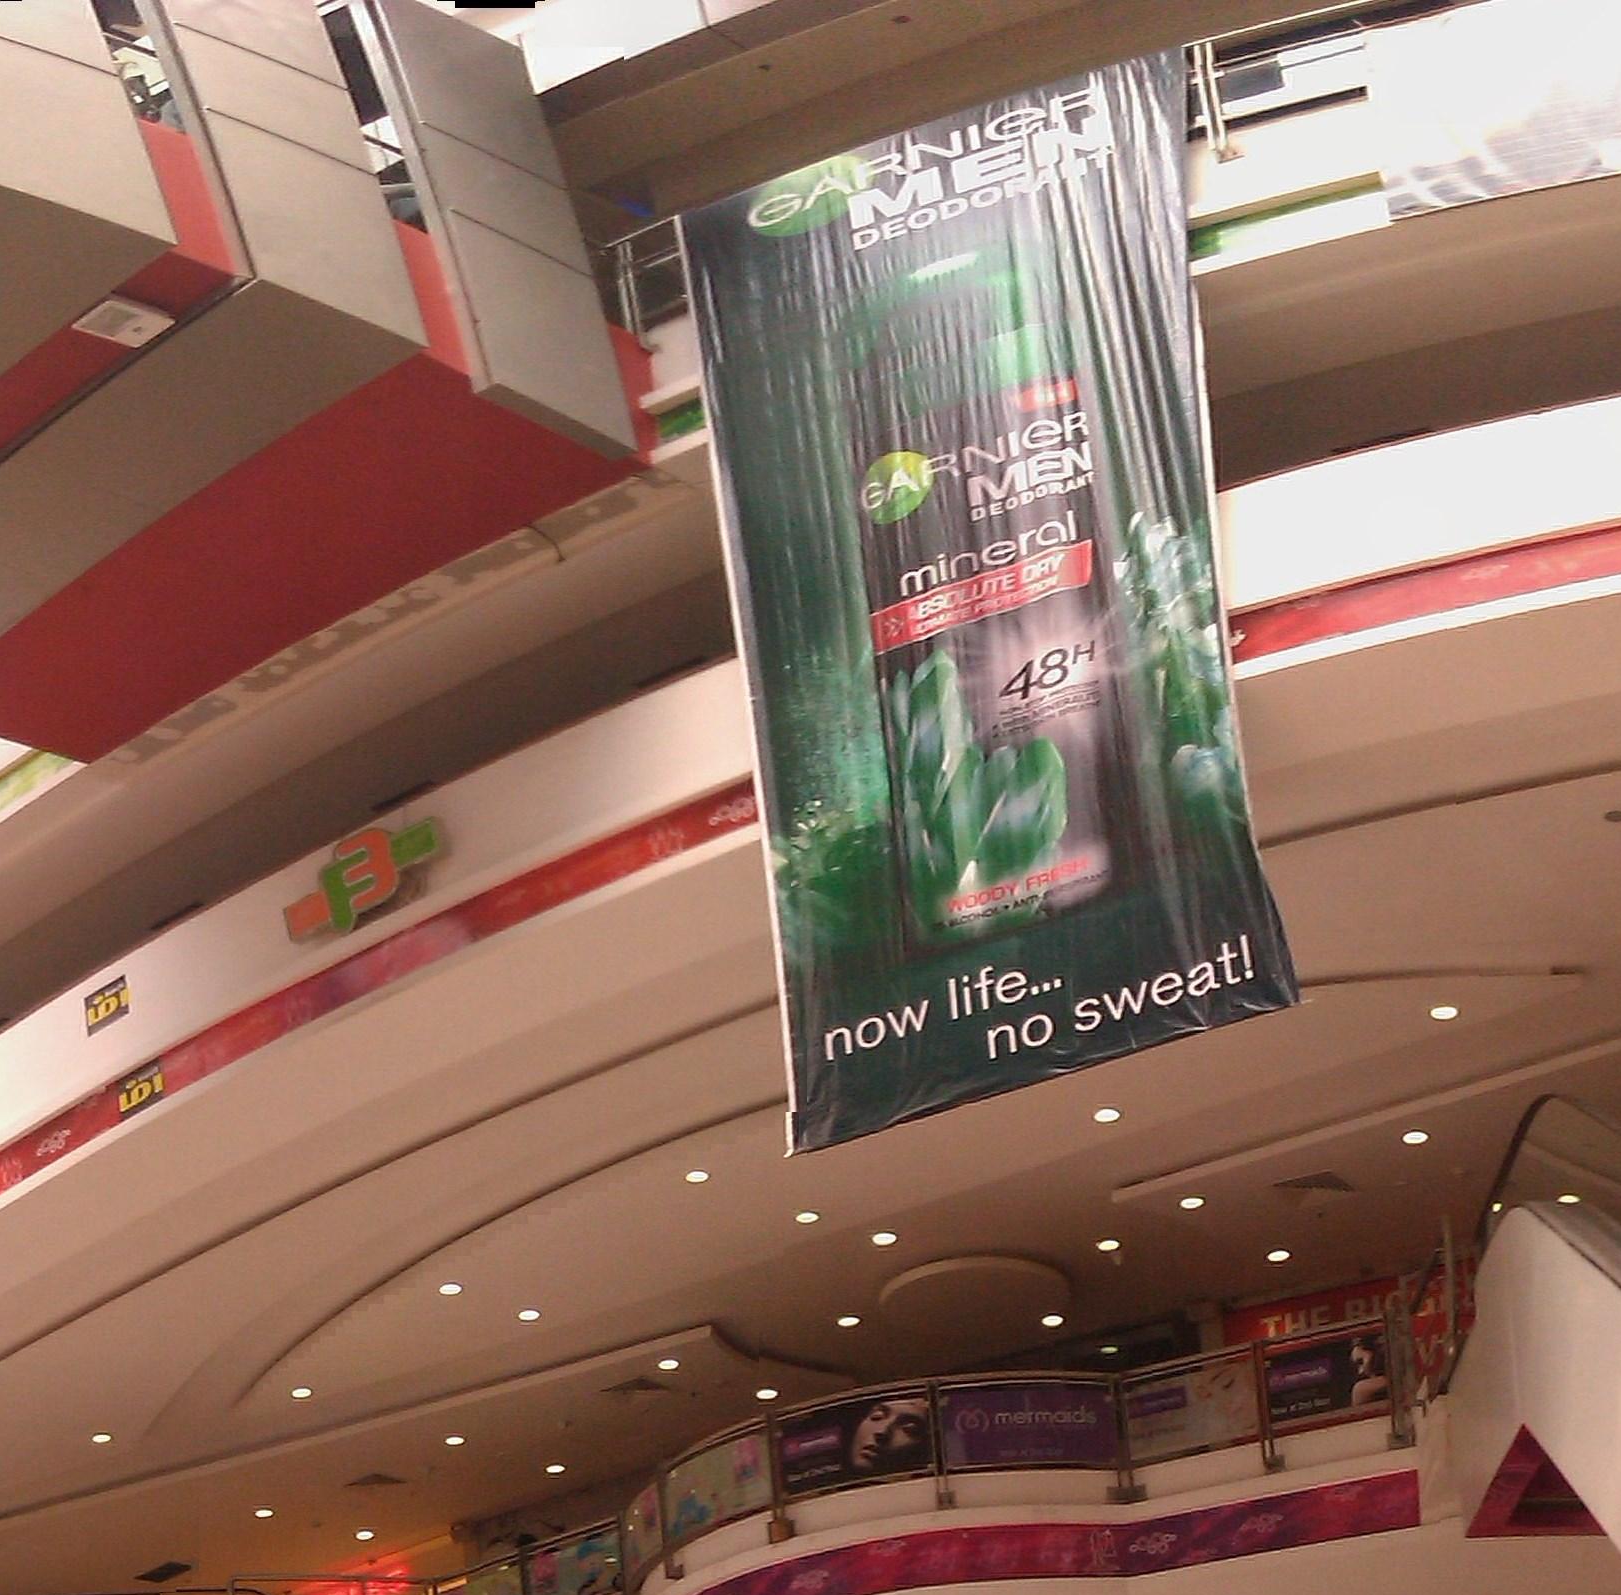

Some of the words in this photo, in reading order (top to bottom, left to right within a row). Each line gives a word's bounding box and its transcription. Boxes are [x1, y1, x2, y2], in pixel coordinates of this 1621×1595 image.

[747, 87, 1101, 227] GARNIER
[848, 129, 1114, 229] MEN
[862, 411, 1089, 510] GARNIER
[968, 442, 1093, 507] MEN
[971, 472, 1095, 522] DEODORANT
[900, 510, 1078, 597] mineral
[947, 881, 1019, 912] WOODY
[824, 999, 929, 1062] now
[948, 965, 1063, 1021] life...
[987, 1013, 1055, 1061] no
[1074, 934, 1254, 1033] sweat!
[995, 1405, 1097, 1426] mermaids
